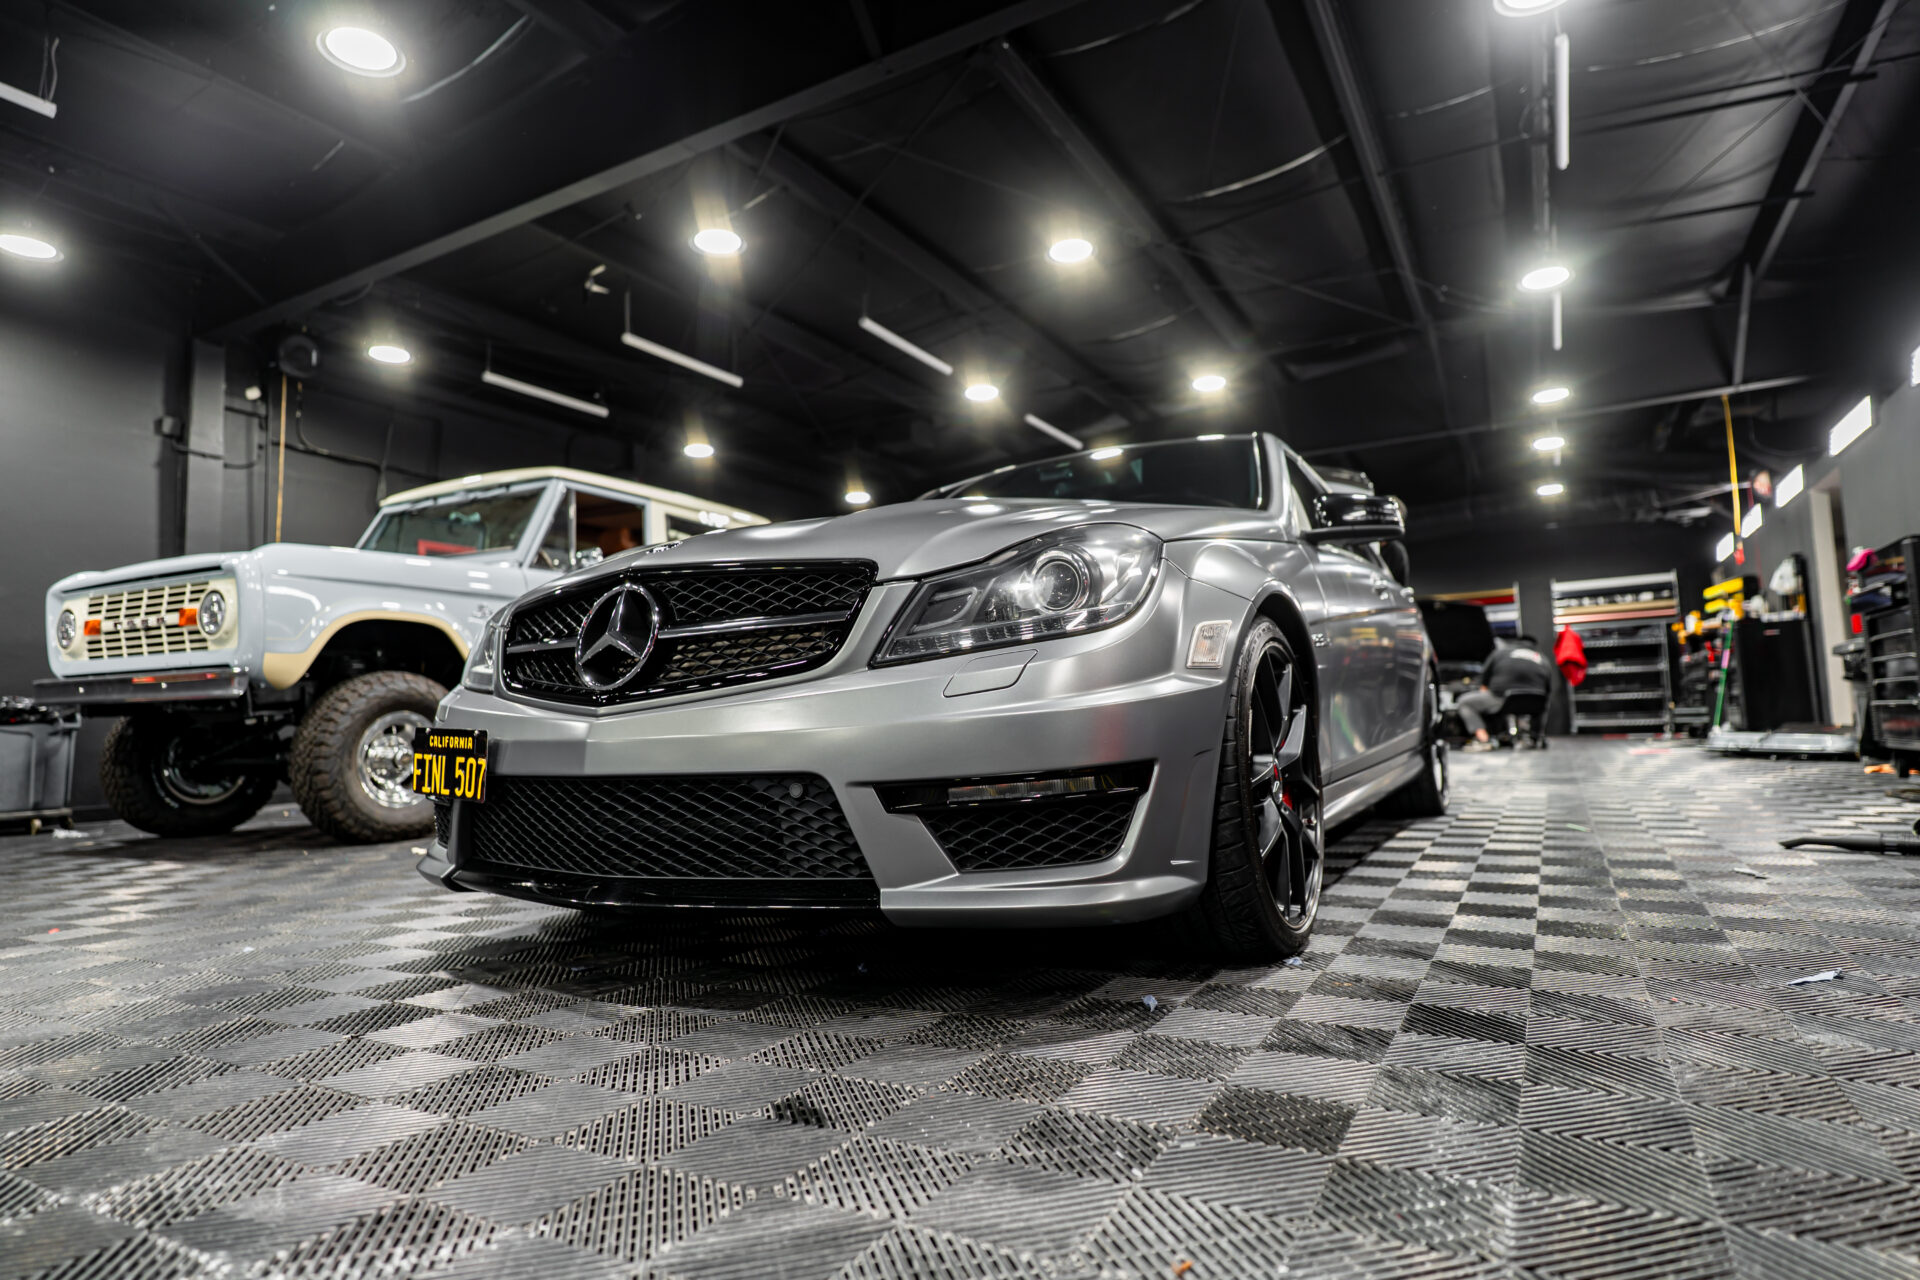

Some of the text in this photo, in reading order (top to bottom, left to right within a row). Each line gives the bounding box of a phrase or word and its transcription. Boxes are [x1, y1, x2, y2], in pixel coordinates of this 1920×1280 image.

[429, 735, 473, 749] CALIFORNIA
[413, 752, 487, 800] FINL 507
